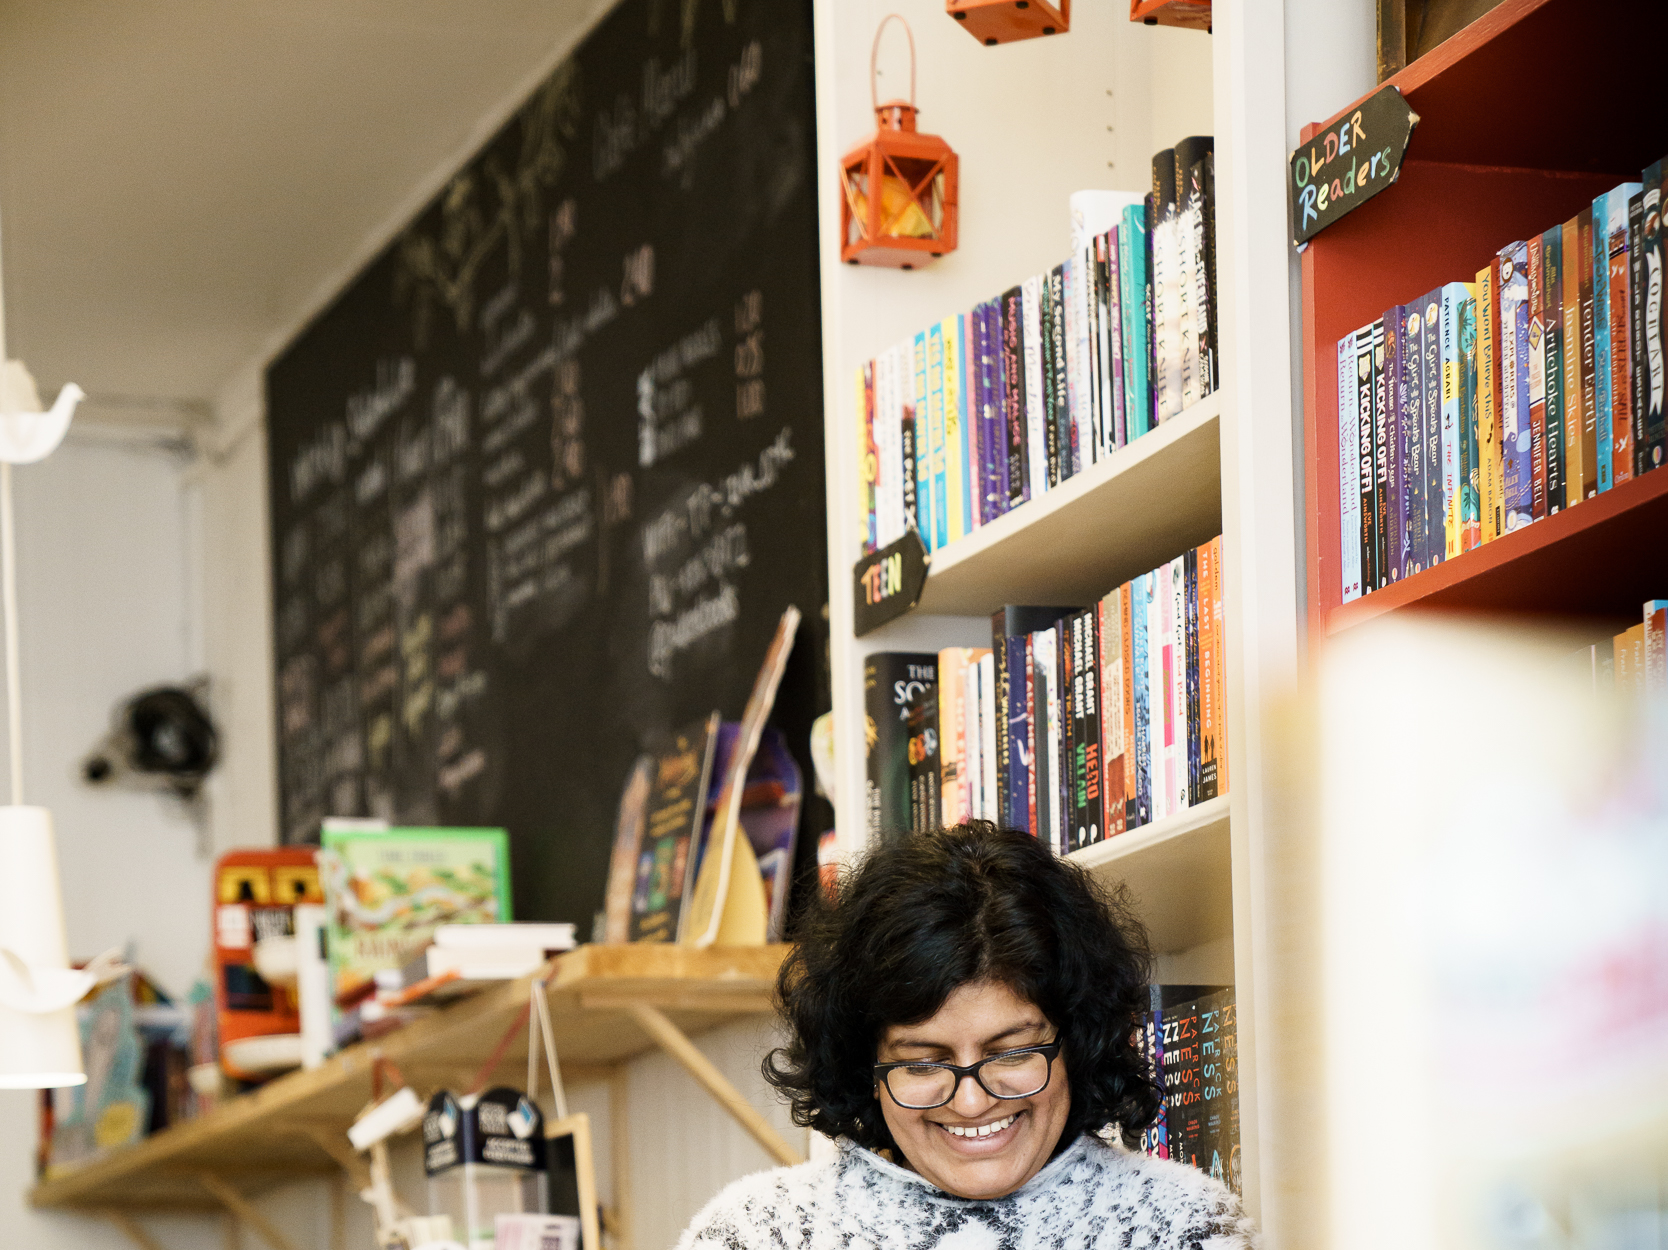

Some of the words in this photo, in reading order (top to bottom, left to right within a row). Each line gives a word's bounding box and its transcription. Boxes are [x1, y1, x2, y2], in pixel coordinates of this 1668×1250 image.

[1295, 110, 1366, 188] OLDER
[1299, 145, 1392, 231] Readers
[1052, 274, 1062, 301] My
[1155, 246, 1165, 329] SHORT
[1178, 235, 1188, 319] SHORT
[1482, 272, 1490, 302] You
[1633, 259, 1641, 305] WILD
[1008, 296, 1018, 348] MUSIC
[1055, 304, 1065, 368] Second
[1565, 306, 1576, 389] Jasmine
[1583, 294, 1595, 368] Tender
[1649, 266, 1662, 392] COGHEART
[1010, 354, 1018, 385] AND
[1057, 372, 1066, 407] Life
[1158, 340, 1167, 412] KNIFE
[1181, 329, 1191, 402] KNIFE
[1483, 344, 1491, 389] Believe
[1546, 319, 1558, 416] Artichoke
[1012, 388, 1021, 447] MALICE
[1360, 383, 1371, 455] KICKING
[1376, 373, 1386, 444] KICKING
[1411, 399, 1420, 442] Speaks
[1428, 389, 1438, 433] Speaks
[1484, 392, 1492, 420] This
[1567, 393, 1576, 447] Skies
[1585, 373, 1595, 433] Earth
[1636, 365, 1644, 440] ESCAPES
[1340, 422, 1349, 515] Wonderland
[1348, 417, 1357, 511] Wonderland
[1361, 455, 1373, 494] OFF!
[1377, 444, 1387, 484] OFF!
[1411, 444, 1420, 475] Bear
[1429, 434, 1438, 466] Bear
[1533, 420, 1542, 475] JENNIFER
[1548, 421, 1558, 491] Hearts
[1534, 478, 1543, 507] BELL
[861, 552, 902, 605] TEEN
[1174, 592, 1182, 620] Good
[1025, 644, 1034, 676] SEE
[1073, 617, 1083, 676] MICHAEL
[1084, 612, 1094, 671] MICHAEL
[1656, 629, 1665, 649] JOY
[908, 664, 935, 681] THE
[1075, 675, 1084, 719] GRANT
[1085, 671, 1095, 715] GRANT
[1204, 650, 1212, 729] BEGINNING
[1076, 742, 1087, 808] VILLAIN
[1086, 743, 1099, 800] HERO
[1202, 764, 1217, 775] LAUREN
[1202, 773, 1217, 784] JAMES
[1171, 1021, 1182, 1108] NESS
[1179, 1018, 1195, 1106] NESS
[1190, 1016, 1201, 1102] PATRICK
[1201, 1012, 1216, 1101] NESS
[1213, 1010, 1223, 1096] PATRICK
[1222, 1006, 1237, 1095] NESS
